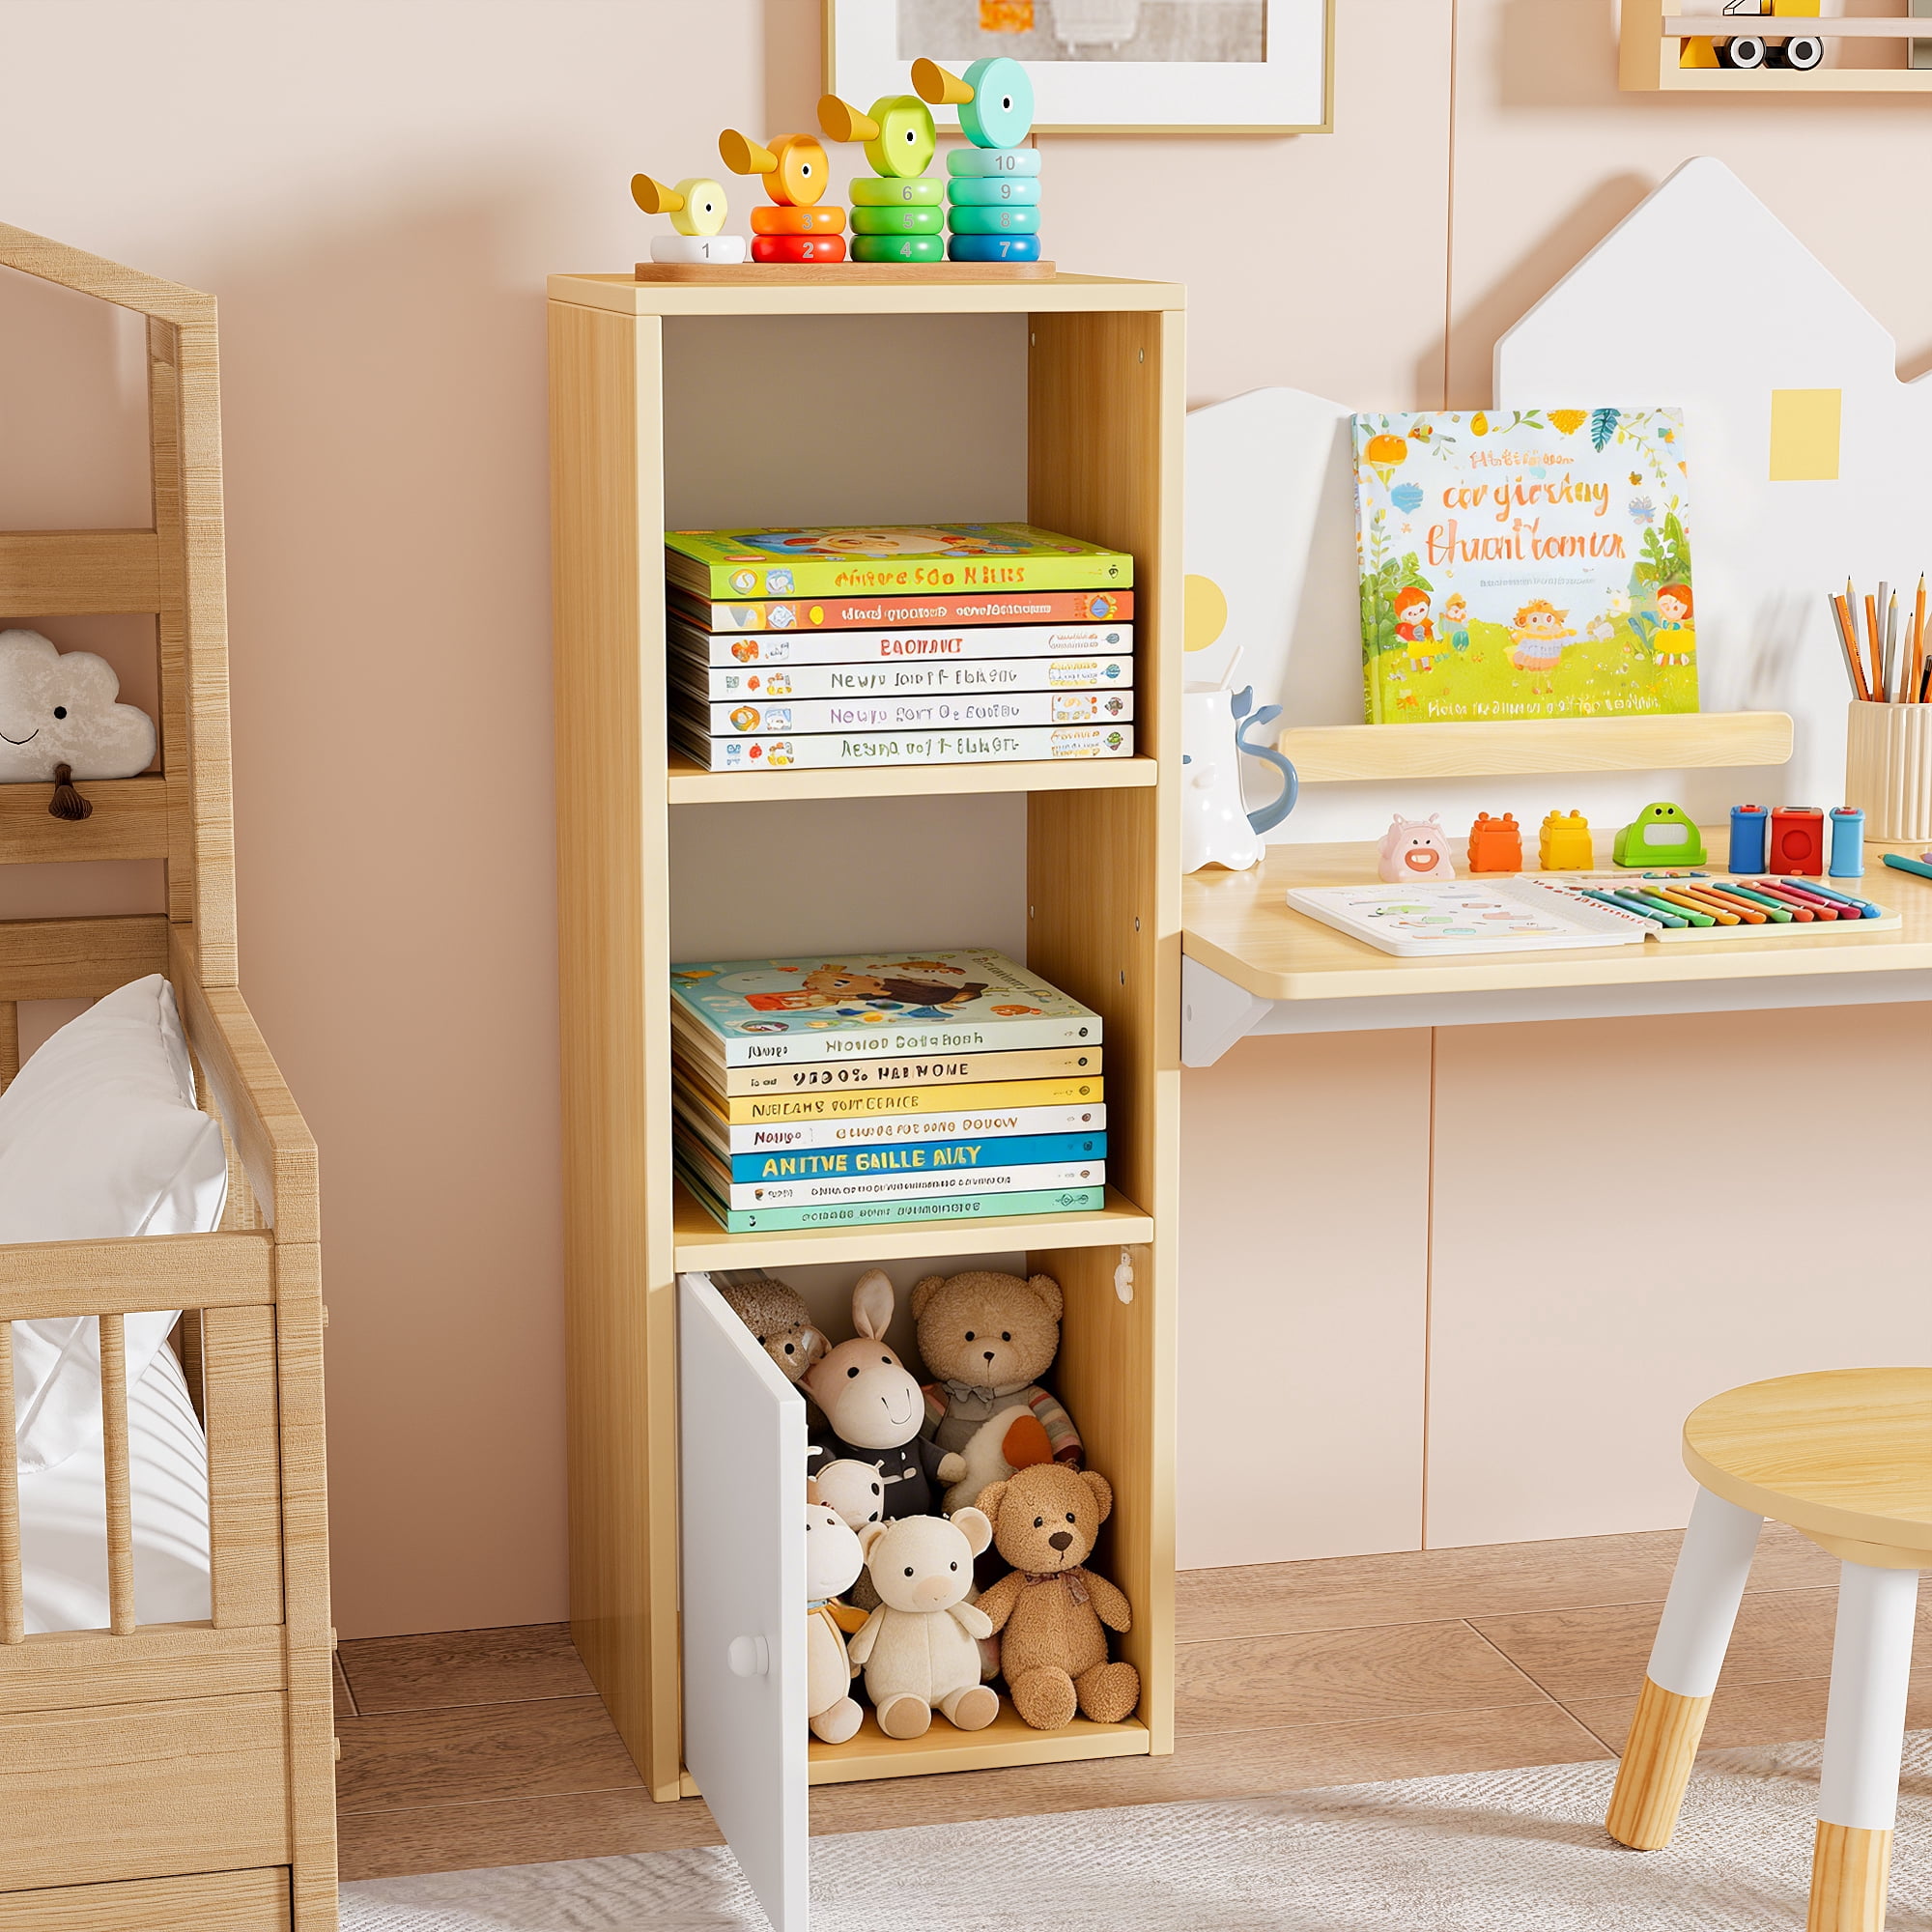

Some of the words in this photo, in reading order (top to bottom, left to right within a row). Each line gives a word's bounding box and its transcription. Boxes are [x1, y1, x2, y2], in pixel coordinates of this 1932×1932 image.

[995, 156, 1015, 171] 10
[902, 185, 913, 201] 6
[1001, 184, 1011, 199] 9
[802, 214, 812, 230] 3
[903, 213, 914, 229] 5
[1000, 213, 1011, 228] 8
[701, 242, 710, 258] 1
[802, 242, 814, 258] 2
[899, 242, 912, 258] 4
[1000, 242, 1011, 258] 7
